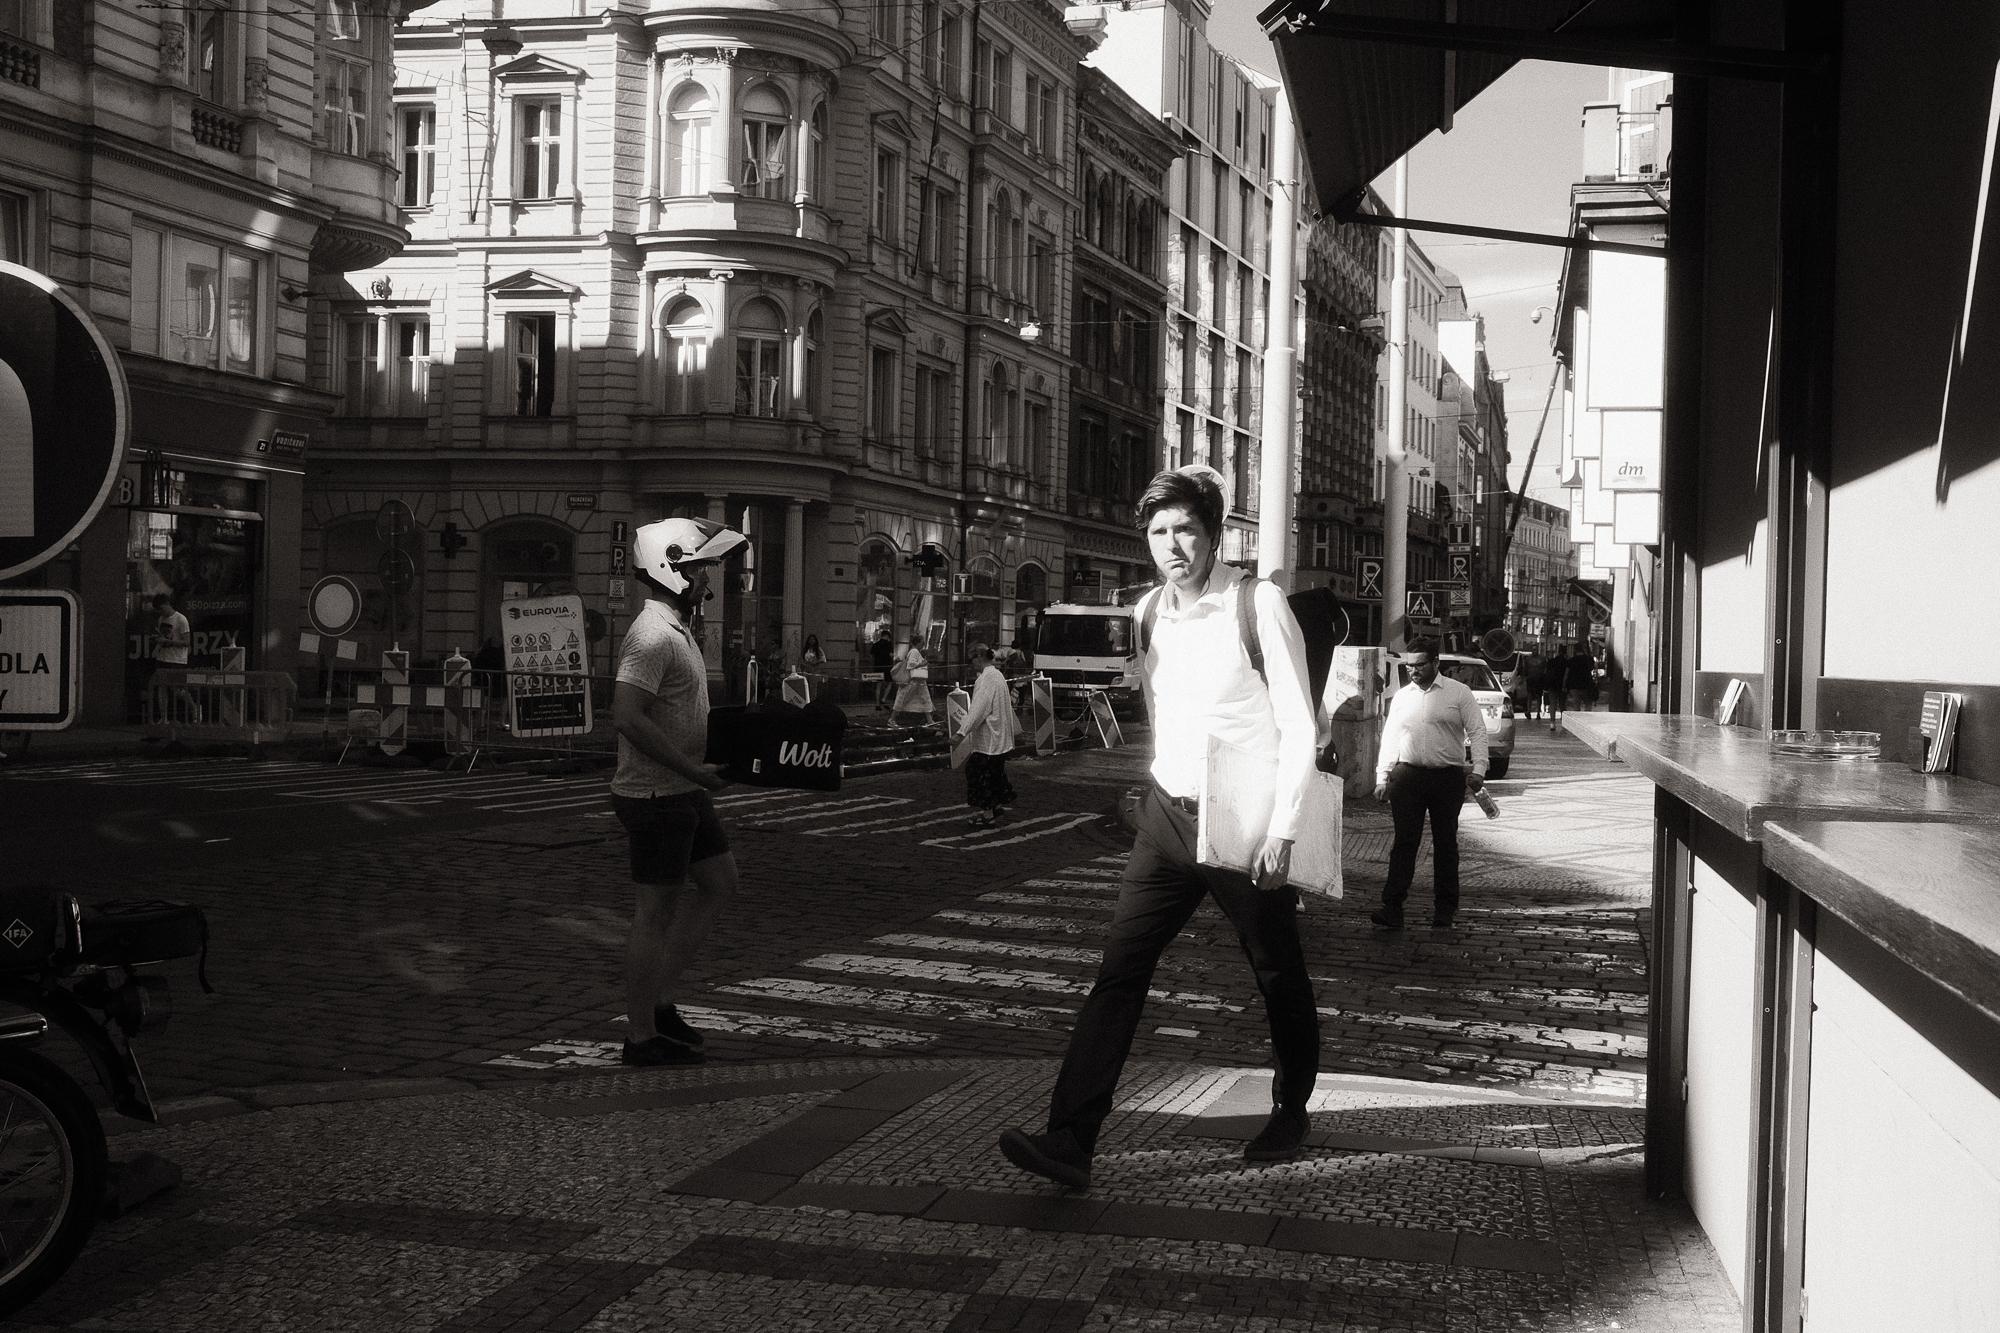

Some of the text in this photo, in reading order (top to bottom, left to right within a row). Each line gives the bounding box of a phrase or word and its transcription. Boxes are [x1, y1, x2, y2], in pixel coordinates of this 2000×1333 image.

[1618, 461, 1644, 475] dm
[522, 606, 570, 617] EUROVIA
[778, 740, 832, 768] Wolt
[8, 928, 28, 939] IFA
